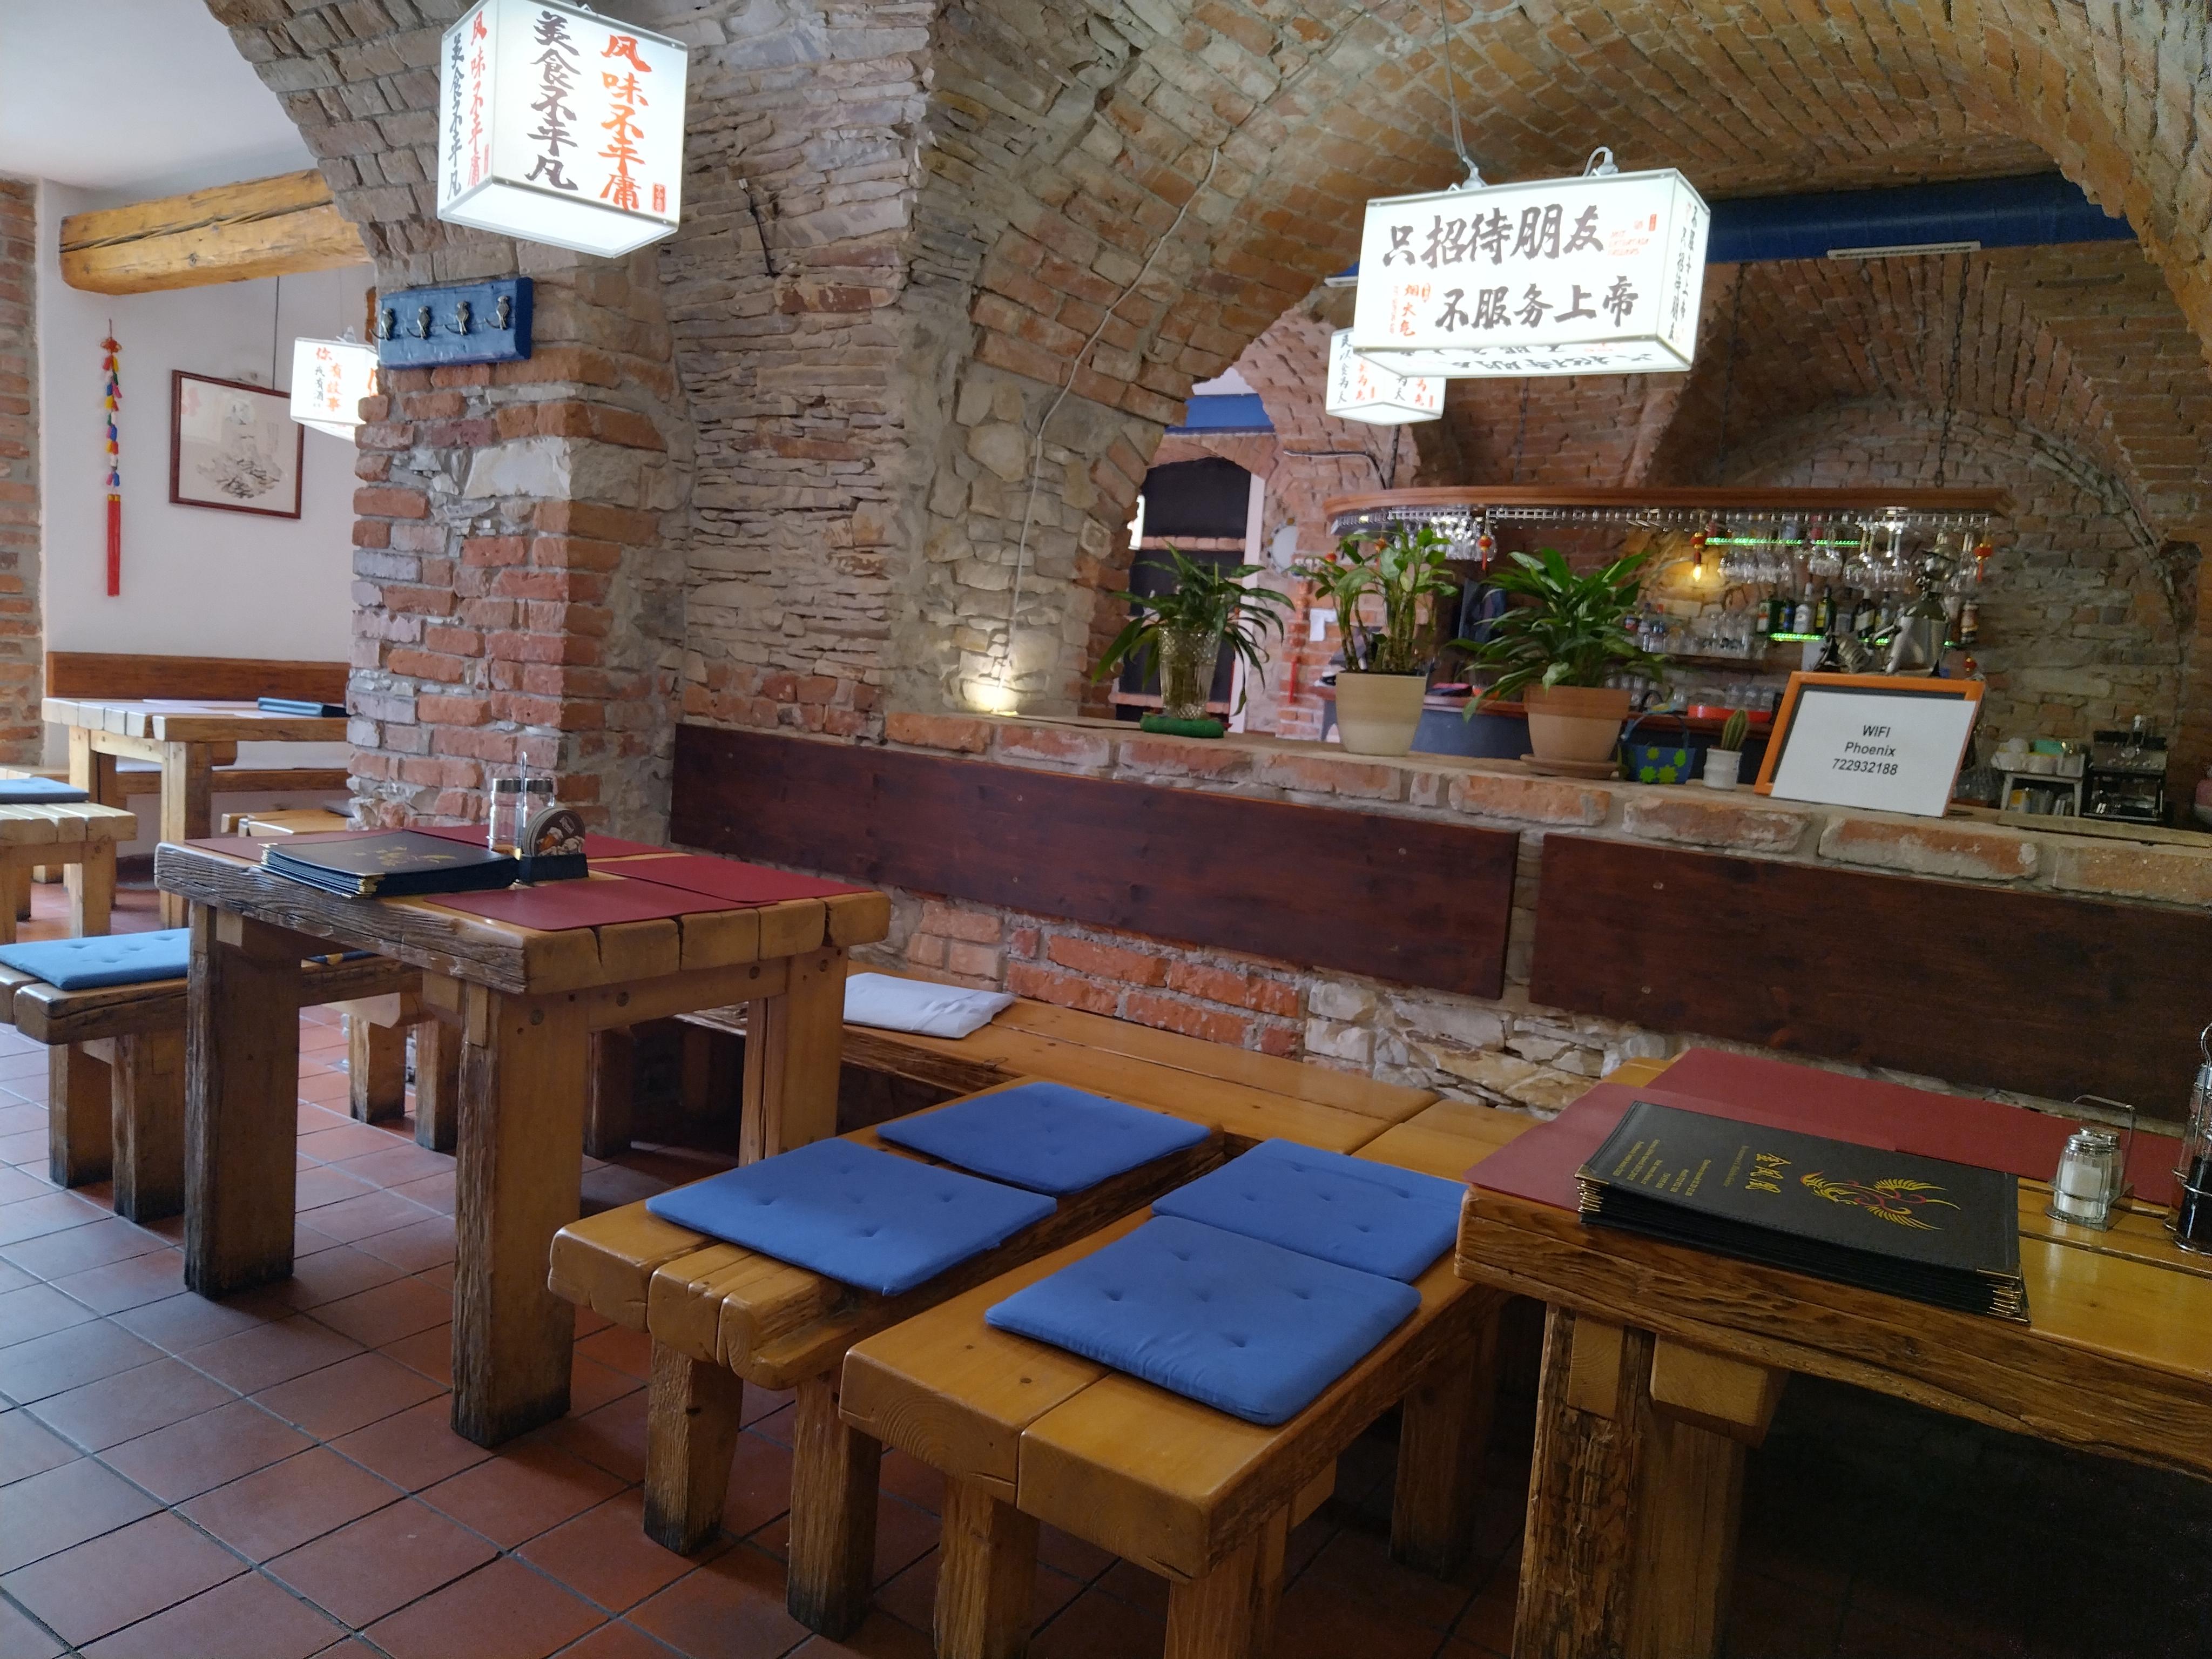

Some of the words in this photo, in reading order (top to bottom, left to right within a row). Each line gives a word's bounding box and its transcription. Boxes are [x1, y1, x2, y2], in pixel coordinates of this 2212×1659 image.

[447, 32, 464, 200] 美食不平凡
[467, 10, 487, 187] 风味不平庸
[524, 10, 581, 190] 美食不平凡
[598, 35, 652, 211] 风味不平庸
[1382, 204, 1605, 269] 只招待朋友
[1435, 275, 1638, 333] 不服务上帝
[1844, 741, 1896, 757] Phoenix
[1863, 725, 1891, 738] WIFI
[1832, 758, 1898, 775] 722932188
